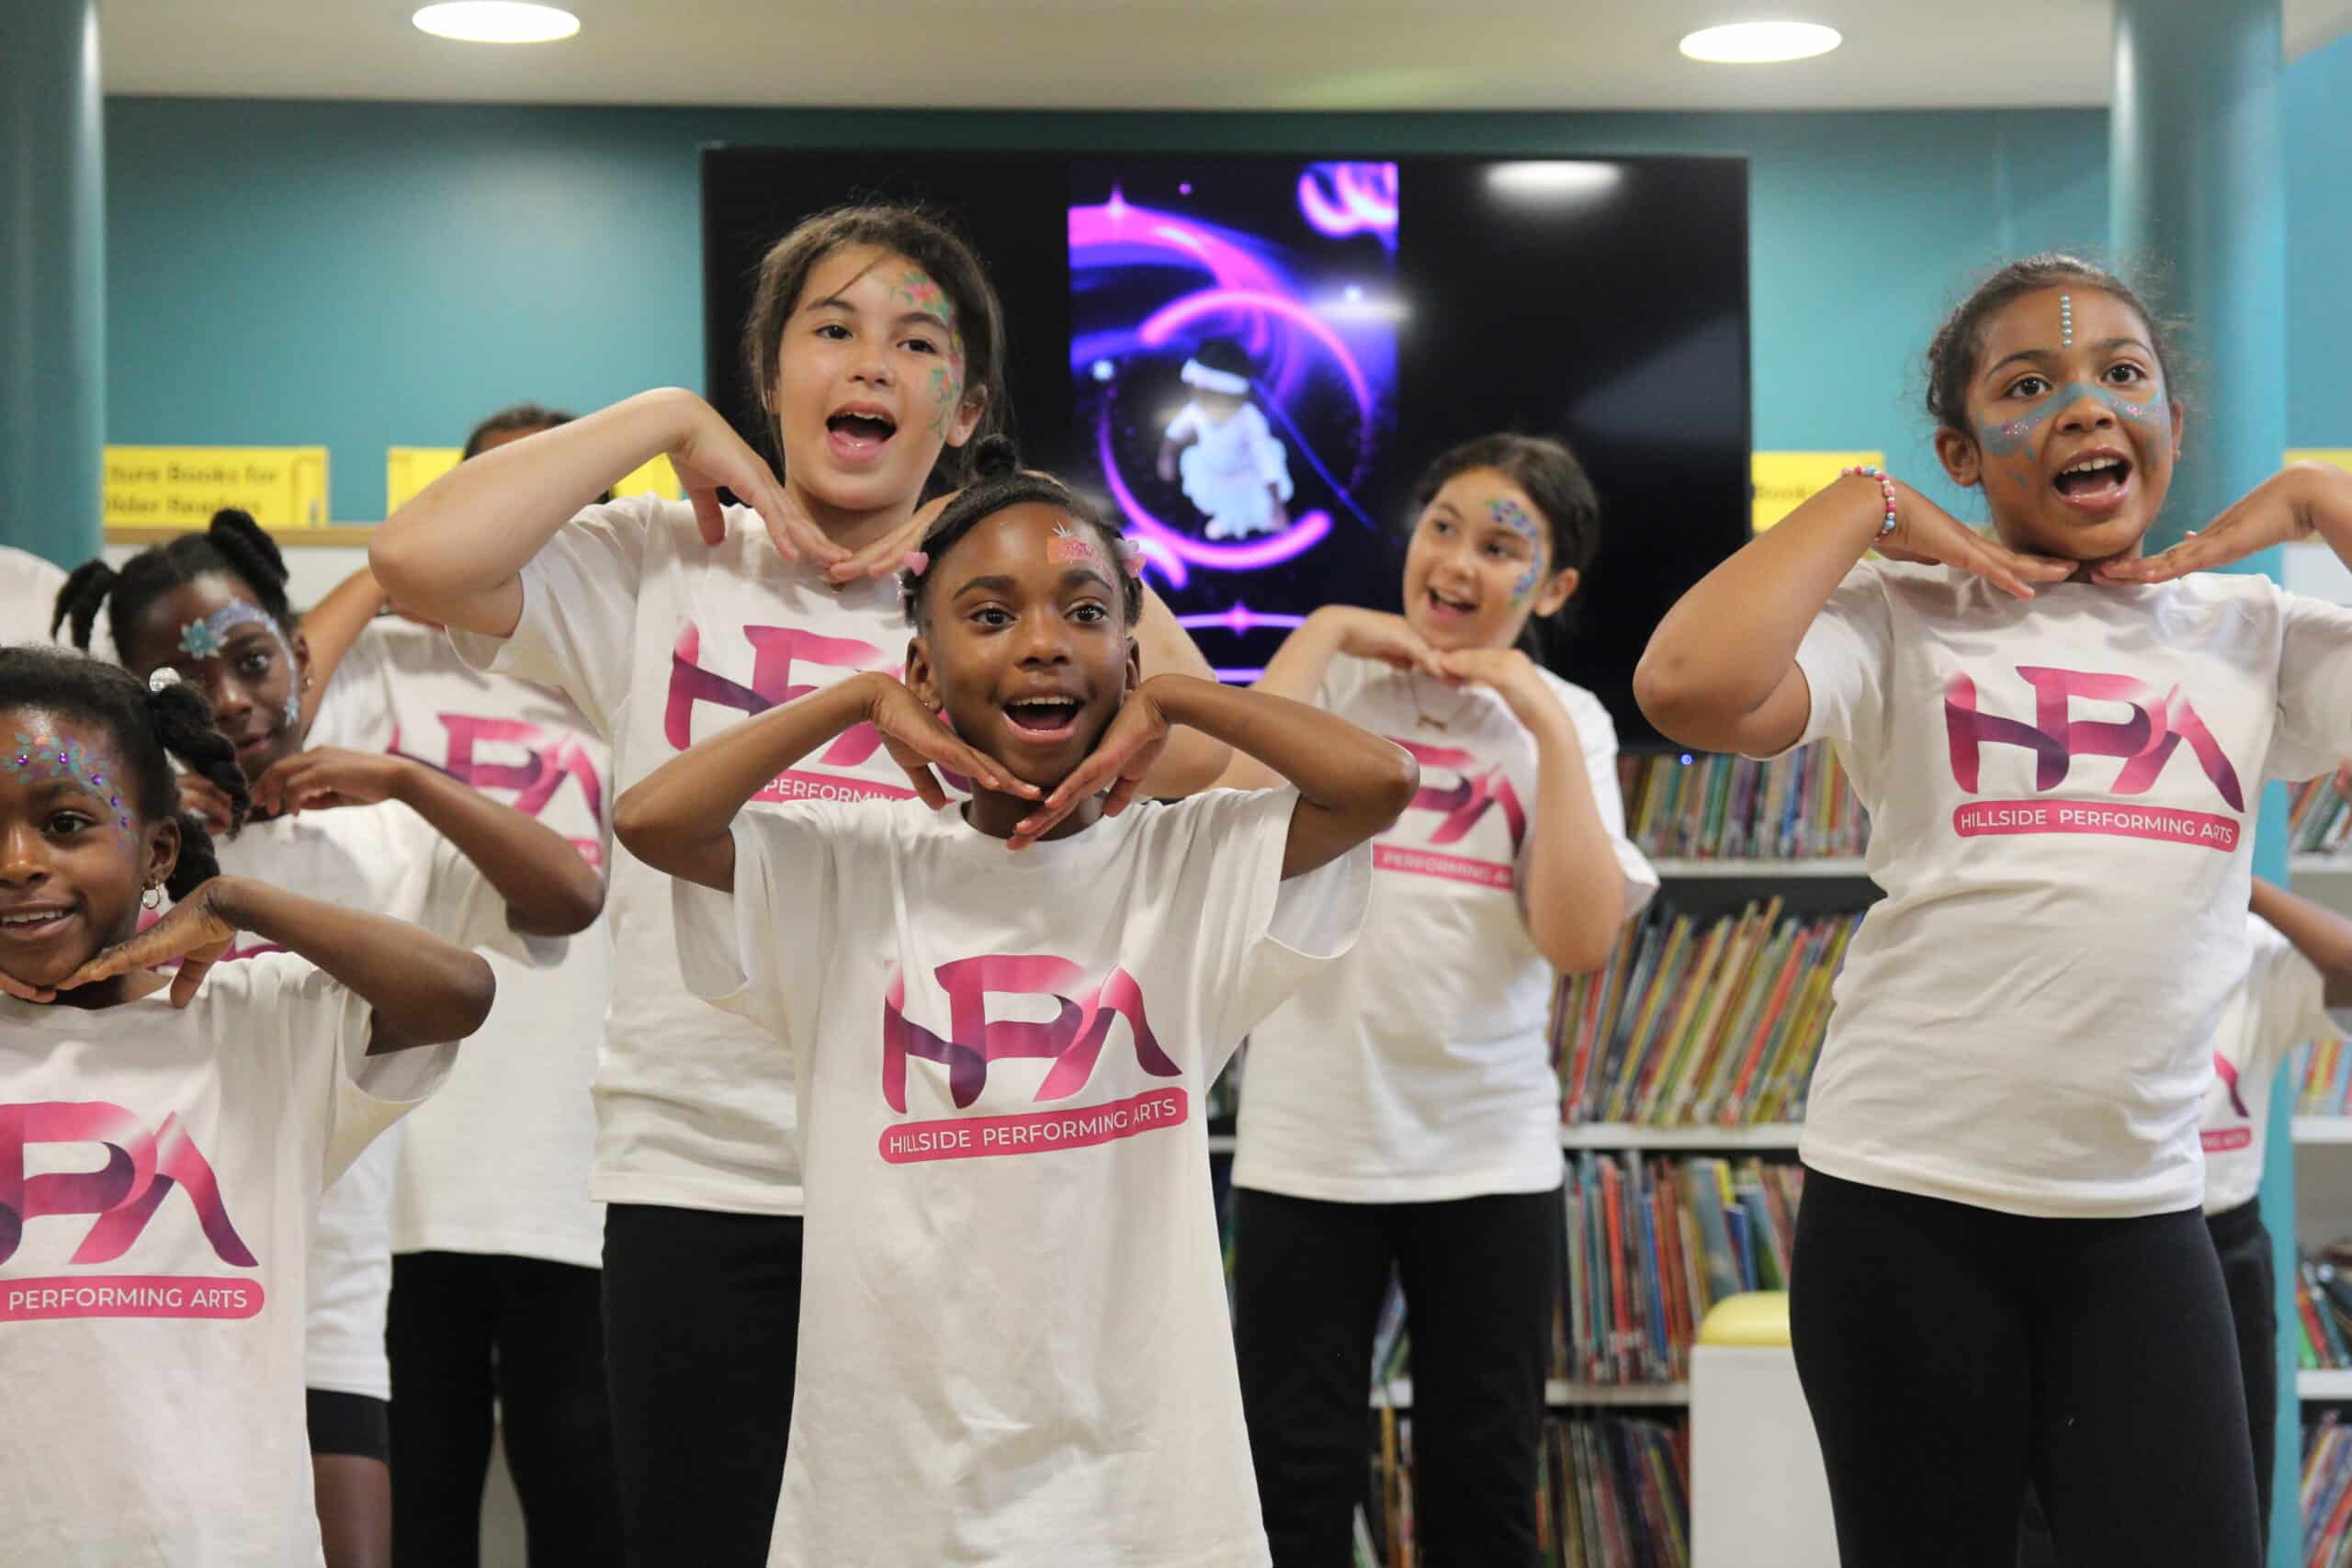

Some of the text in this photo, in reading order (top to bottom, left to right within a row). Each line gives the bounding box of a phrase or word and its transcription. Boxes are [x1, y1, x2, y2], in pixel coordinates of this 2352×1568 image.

[166, 461, 239, 483] Books
[1943, 666, 2245, 814] HPA
[763, 778, 899, 803] PERFORMI
[1961, 808, 2233, 845] HILLSIDE PERFORMING ARTS
[882, 953, 1182, 1114] HPA
[888, 1098, 1178, 1155] HILLSIDE PERFORMING ARTS
[8, 1288, 248, 1311] PERFORMING ARTS
